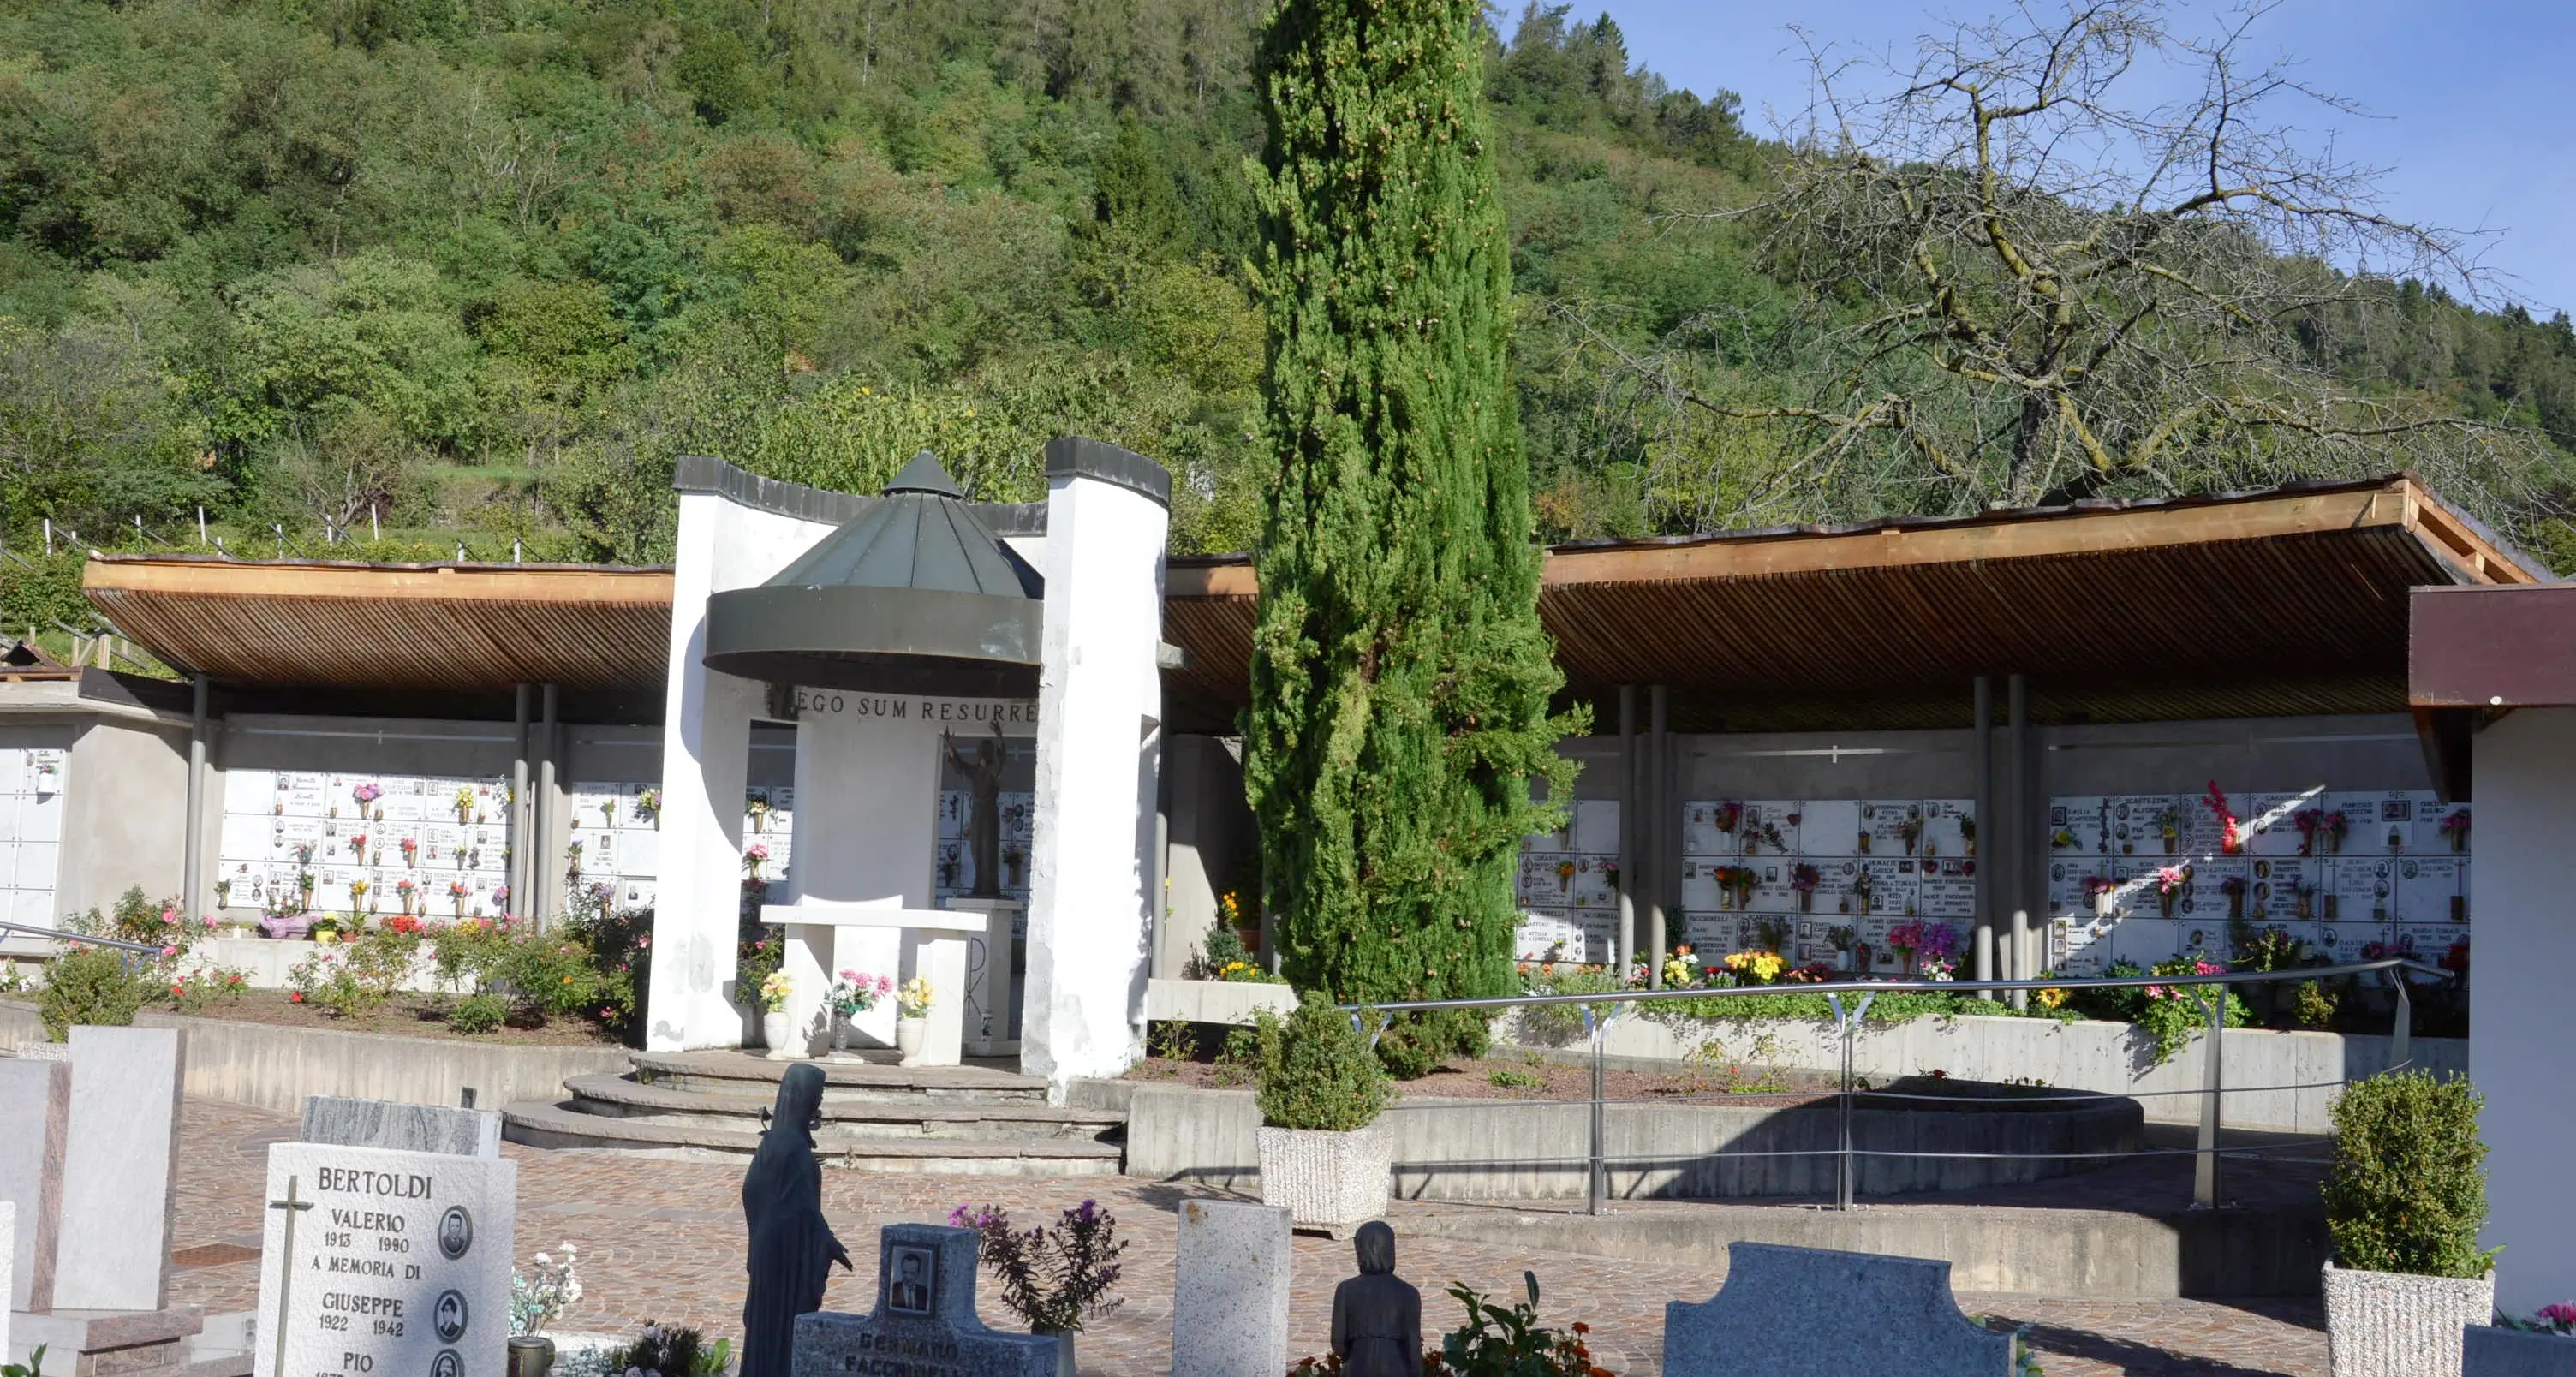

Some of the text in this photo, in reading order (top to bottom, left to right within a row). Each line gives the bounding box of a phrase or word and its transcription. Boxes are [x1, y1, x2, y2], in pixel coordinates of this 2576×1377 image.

[797, 692, 844, 713] EGO
[857, 698, 907, 718] SUM
[318, 1167, 432, 1199] BERTOLDI
[331, 1208, 405, 1233] VALERIO
[325, 1232, 410, 1253] 1913 1990
[312, 1255, 420, 1280] A MEMORIA DI
[322, 1292, 404, 1318] GIUSEPPE
[319, 1314, 404, 1337] 1922 1942
[343, 1351, 374, 1373] PIO
